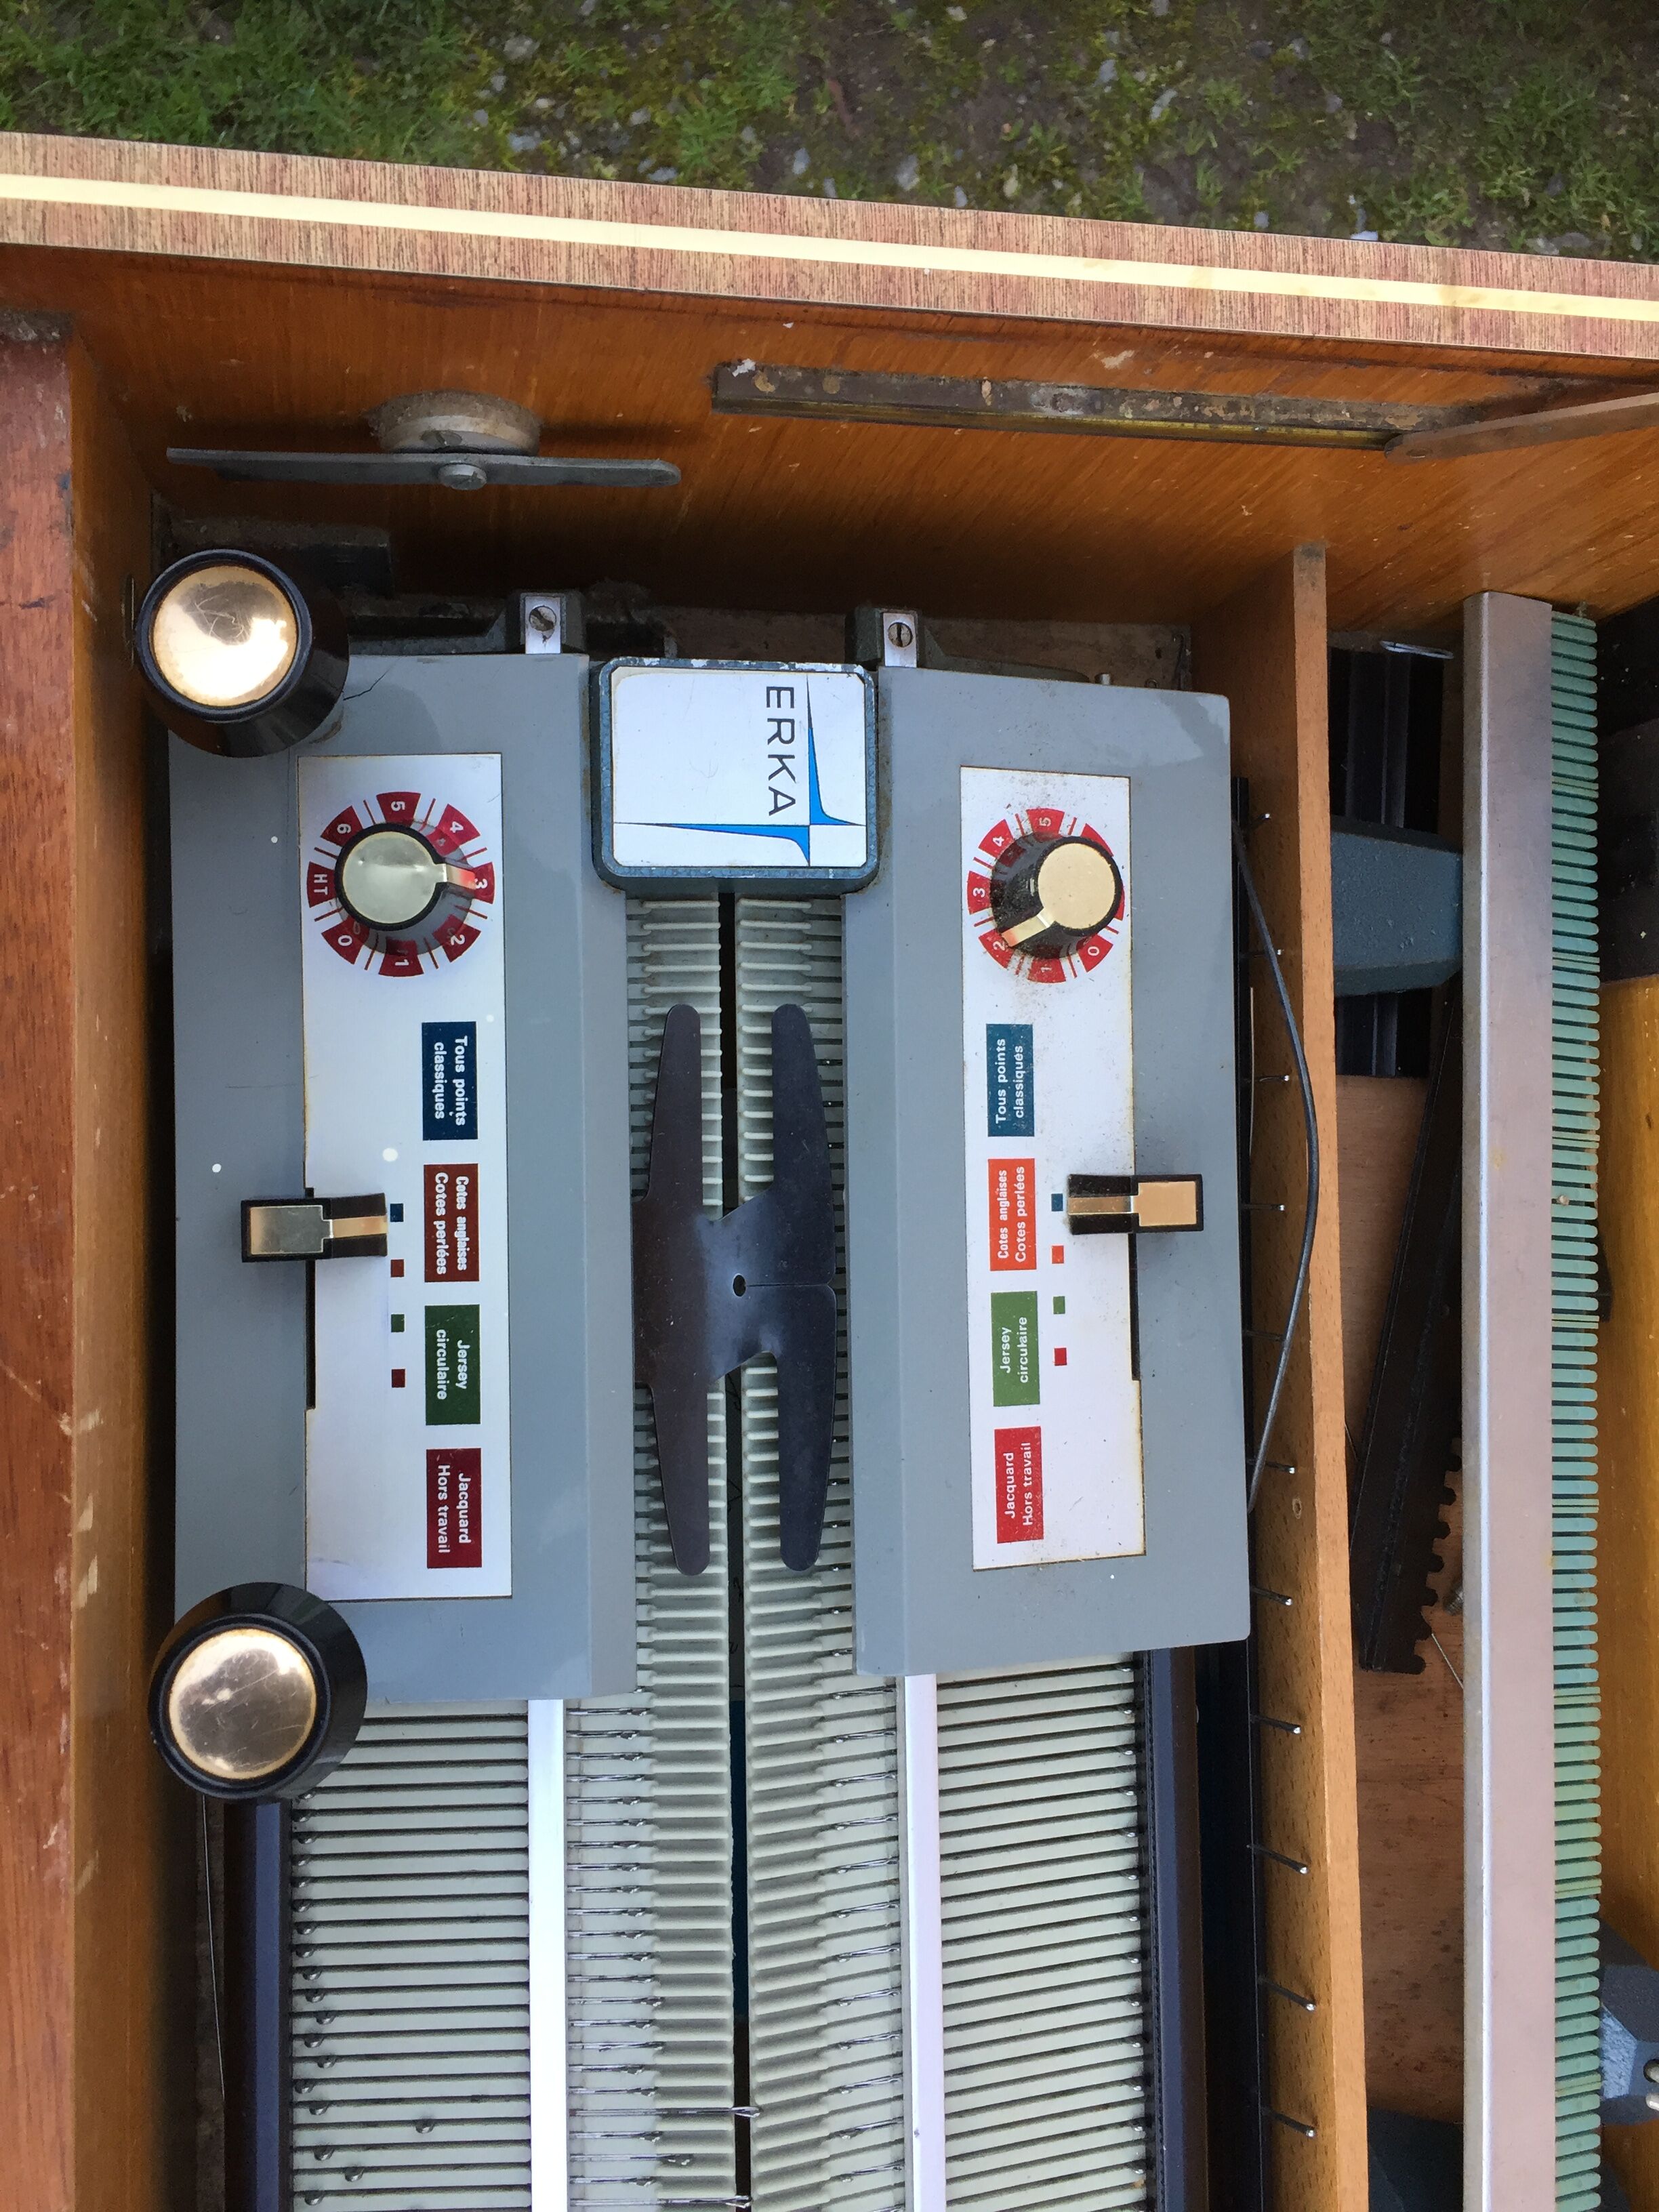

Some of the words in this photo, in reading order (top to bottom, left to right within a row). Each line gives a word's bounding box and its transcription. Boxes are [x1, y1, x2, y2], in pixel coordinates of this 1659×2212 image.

[766, 686, 797, 816] ERKA
[391, 800, 405, 811] 5
[449, 821, 464, 833] 4
[1039, 817, 1051, 827] 5
[337, 823, 352, 834] 6
[992, 836, 1005, 846] 4
[314, 874, 327, 895] HT
[474, 879, 488, 889] 3
[972, 887, 985, 898] 3
[451, 934, 466, 945] 2
[993, 941, 1006, 951] 2
[455, 1036, 468, 1073] Tous
[995, 1038, 1008, 1083] points
[432, 1042, 447, 1119] classiques
[453, 1079, 468, 1126] points
[1012, 1045, 1025, 1118] classiques
[996, 1088, 1006, 1124] Tous
[435, 1172, 449, 1216] Cotes
[456, 1176, 469, 1210] Cotes
[998, 1170, 1010, 1221] anglaises
[1014, 1166, 1028, 1217] perlées
[433, 1221, 449, 1275] perlées
[454, 1216, 470, 1271] anglaises
[998, 1227, 1009, 1259] Cotes
[1015, 1221, 1026, 1263] Cotes
[436, 1329, 449, 1400] circulaire
[455, 1340, 471, 1389] Jersey
[1000, 1327, 1012, 1374] Jersey
[1017, 1317, 1029, 1383] circulaire
[438, 1465, 451, 1500] Hors
[1003, 1452, 1017, 1519] Jacquard
[1021, 1442, 1032, 1488] travail
[438, 1504, 451, 1553] travail
[456, 1473, 472, 1543] Jacquard
[1023, 1492, 1033, 1526] Hors
